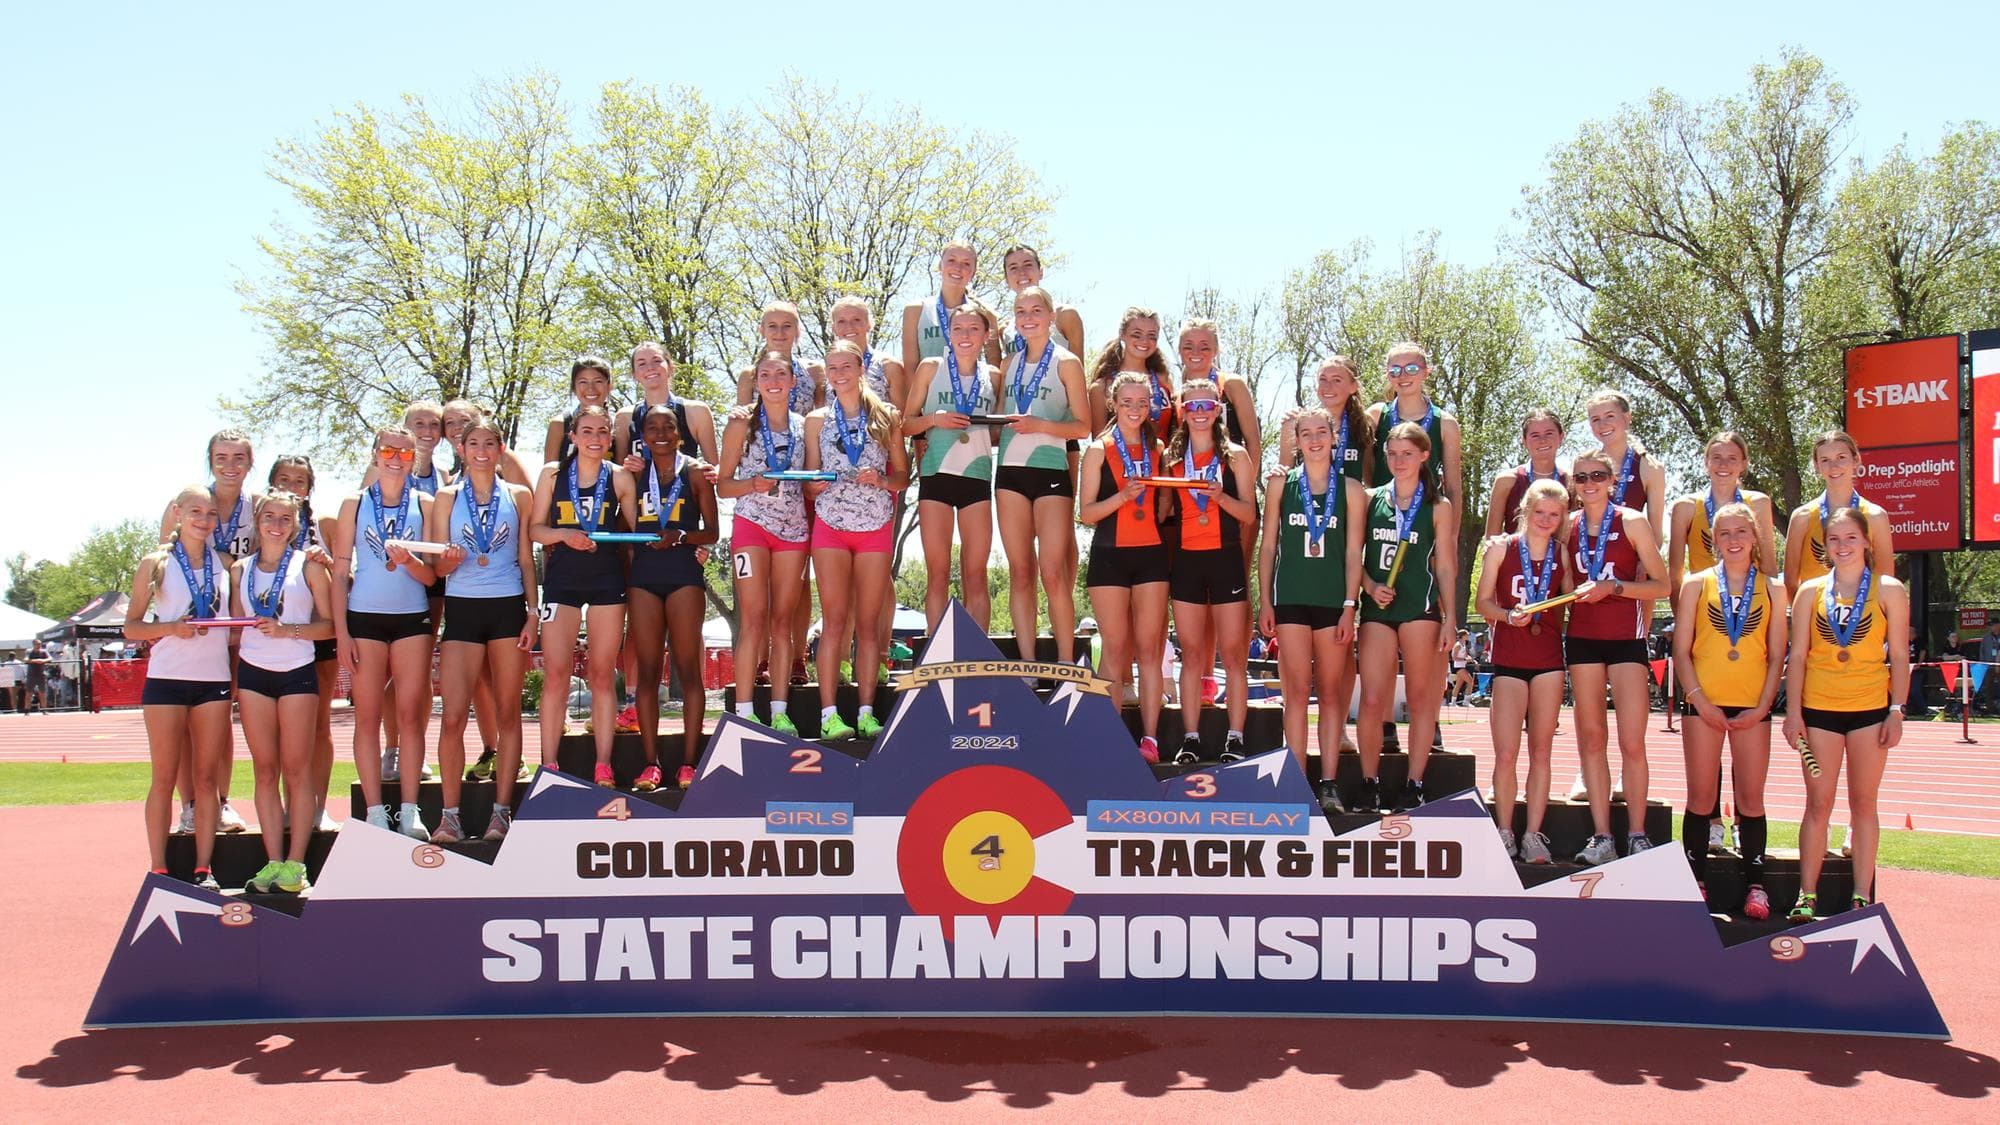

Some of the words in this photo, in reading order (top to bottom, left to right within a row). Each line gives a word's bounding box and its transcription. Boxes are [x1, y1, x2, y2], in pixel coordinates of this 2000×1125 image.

[938, 391, 992, 412] NIOT
[1868, 463, 1896, 478] Prep
[1897, 459, 1955, 478] Spotlight
[1863, 481, 1874, 490] We
[1874, 481, 1892, 489] cover
[1892, 479, 1912, 488] JeffCo
[1912, 478, 1940, 487] Athletics
[234, 538, 250, 554] 13
[736, 554, 748, 577] 2
[1834, 605, 1851, 625] 12
[919, 663, 977, 677] STATE
[983, 663, 1086, 678] CHAMPION
[967, 702, 993, 729] 1
[951, 735, 1019, 750] 2024
[788, 748, 824, 774] 2
[1184, 774, 1217, 798] 3
[596, 796, 632, 821] 4
[766, 810, 849, 826] GIRLS
[1098, 810, 1201, 826] 4X800M
[1210, 811, 1301, 827] RELAY
[1378, 815, 1413, 840] 5
[411, 843, 446, 869] 6
[970, 834, 1005, 858] 4
[576, 839, 855, 879] COLORADO
[978, 856, 1001, 871] a
[1086, 840, 1266, 877] TRACK
[1277, 840, 1314, 878] &
[1323, 840, 1463, 879] FIELD
[1569, 871, 1604, 900] 7
[218, 901, 254, 927] 8
[481, 916, 754, 982] STATE
[770, 915, 1537, 983] CHAMPIONSHIPS
[1768, 934, 1808, 963] 9
